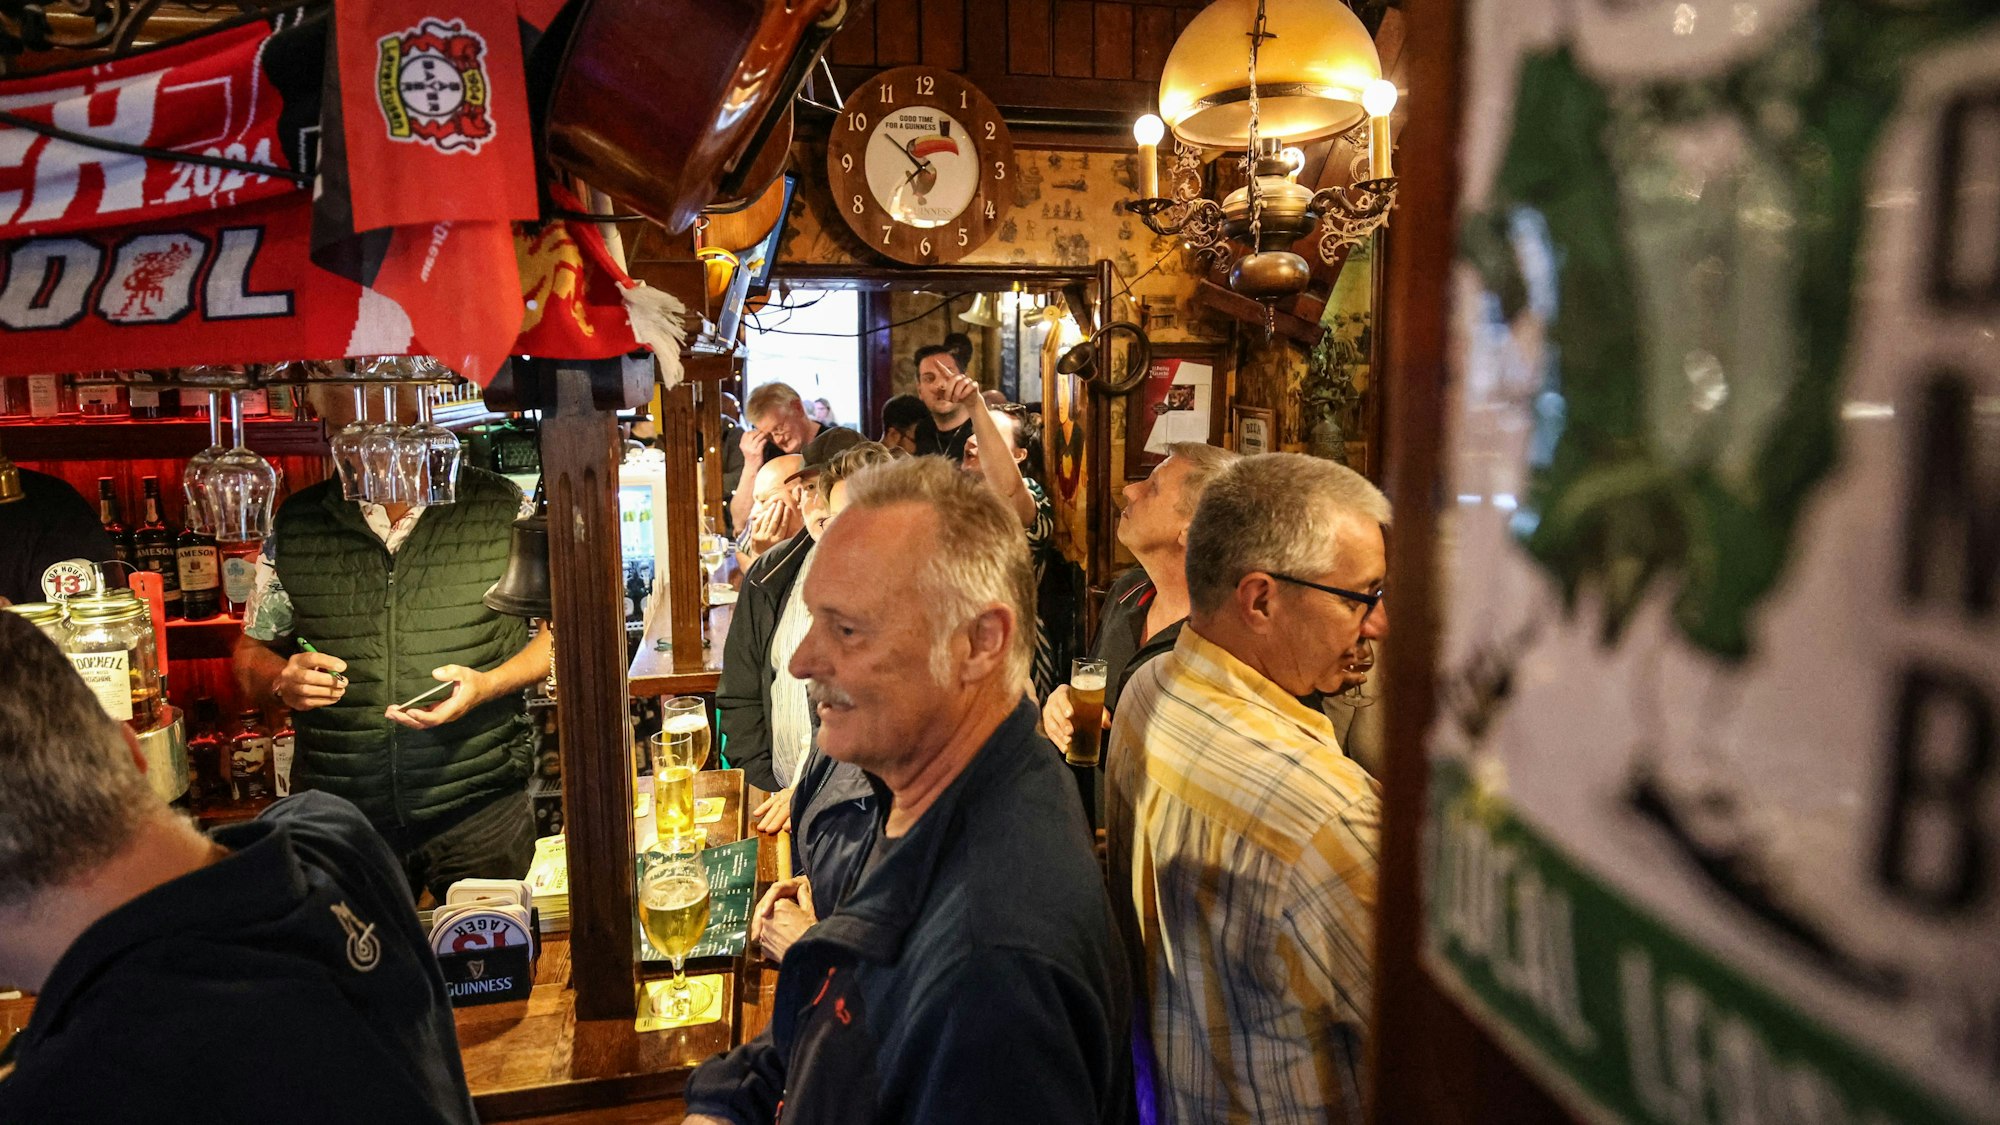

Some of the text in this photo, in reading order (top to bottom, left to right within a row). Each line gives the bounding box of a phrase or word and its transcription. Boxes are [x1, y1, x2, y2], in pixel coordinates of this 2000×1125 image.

[880, 84, 893, 104] 11
[915, 76, 934, 96] 12
[960, 90, 967, 109] 1
[848, 112, 867, 132] 10
[984, 121, 996, 140] 2
[163, 138, 274, 203] 2024
[842, 153, 854, 174] 9
[994, 161, 1006, 180] 3
[852, 194, 864, 214] 8
[984, 200, 996, 220] 4
[882, 225, 892, 245] 7
[958, 228, 968, 246] 5
[920, 237, 931, 256] 6
[137, 547, 174, 558] AMESON
[61, 566, 84, 582] HOUSE
[50, 575, 80, 594] 13
[53, 592, 68, 600] LAG
[453, 919, 512, 936] LAGER
[445, 977, 513, 997] GUINNESS
